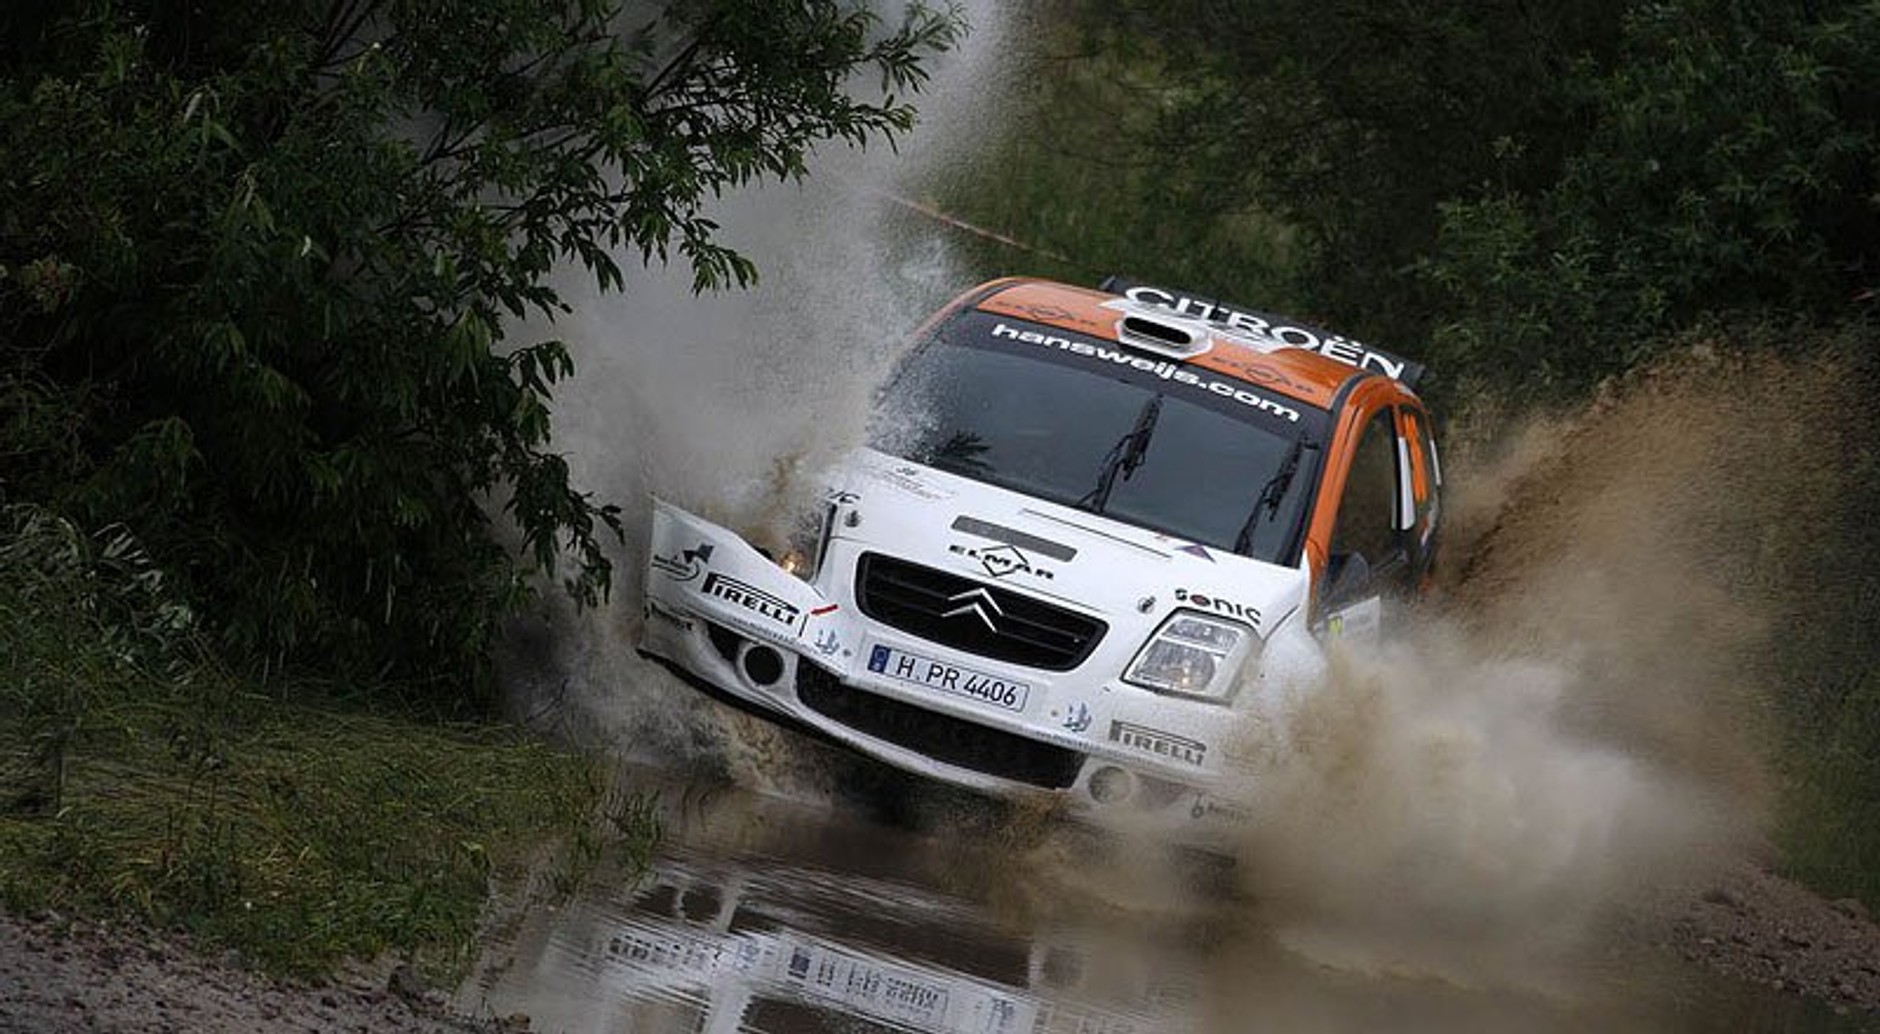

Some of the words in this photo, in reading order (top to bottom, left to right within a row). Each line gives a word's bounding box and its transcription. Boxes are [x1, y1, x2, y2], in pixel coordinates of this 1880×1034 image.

[1125, 286, 1406, 381] CITROËN
[991, 323, 1300, 422] hansweijs.com
[701, 571, 800, 626] PIRELLI
[925, 662, 961, 690] PR
[962, 674, 1017, 706] 4406
[1108, 719, 1207, 766] PIRELLI
